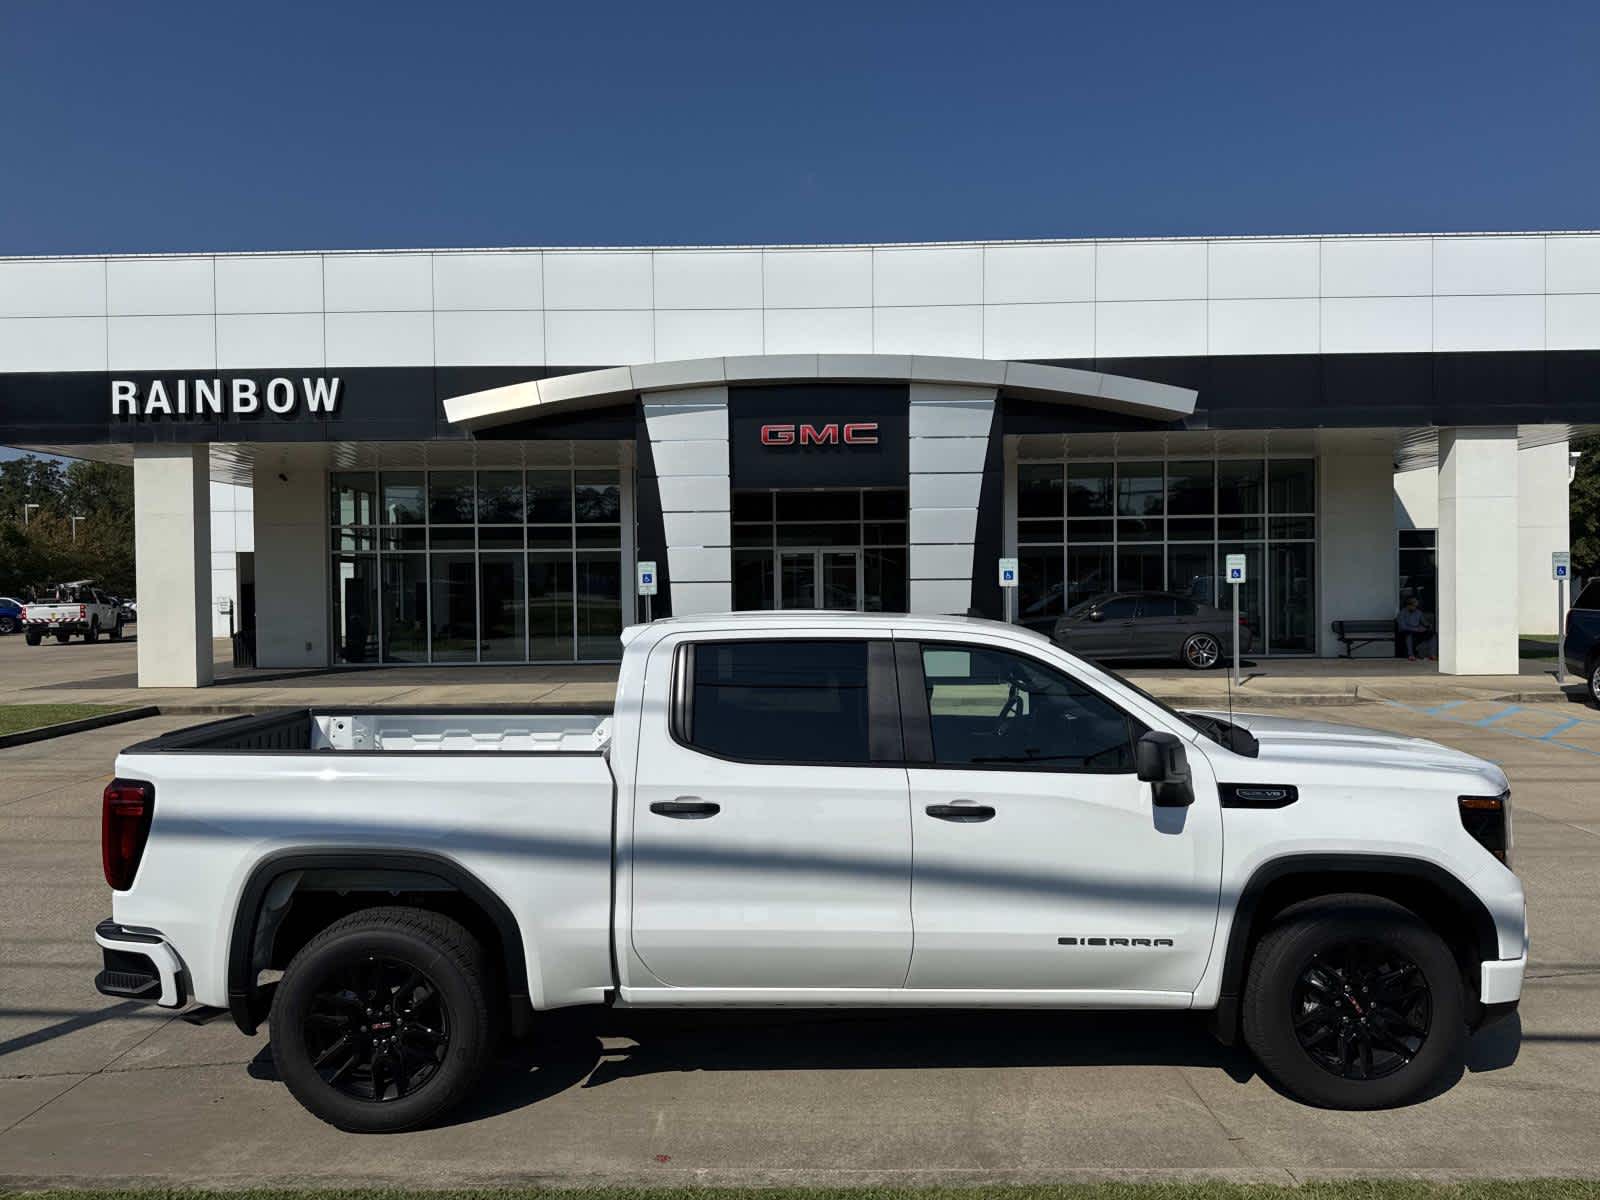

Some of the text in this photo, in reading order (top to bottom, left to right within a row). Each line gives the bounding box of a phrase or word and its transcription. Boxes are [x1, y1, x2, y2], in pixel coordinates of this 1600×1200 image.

[111, 377, 340, 415] RAINBOW
[761, 423, 879, 445] GMC
[1057, 937, 1174, 946] SIERRA
